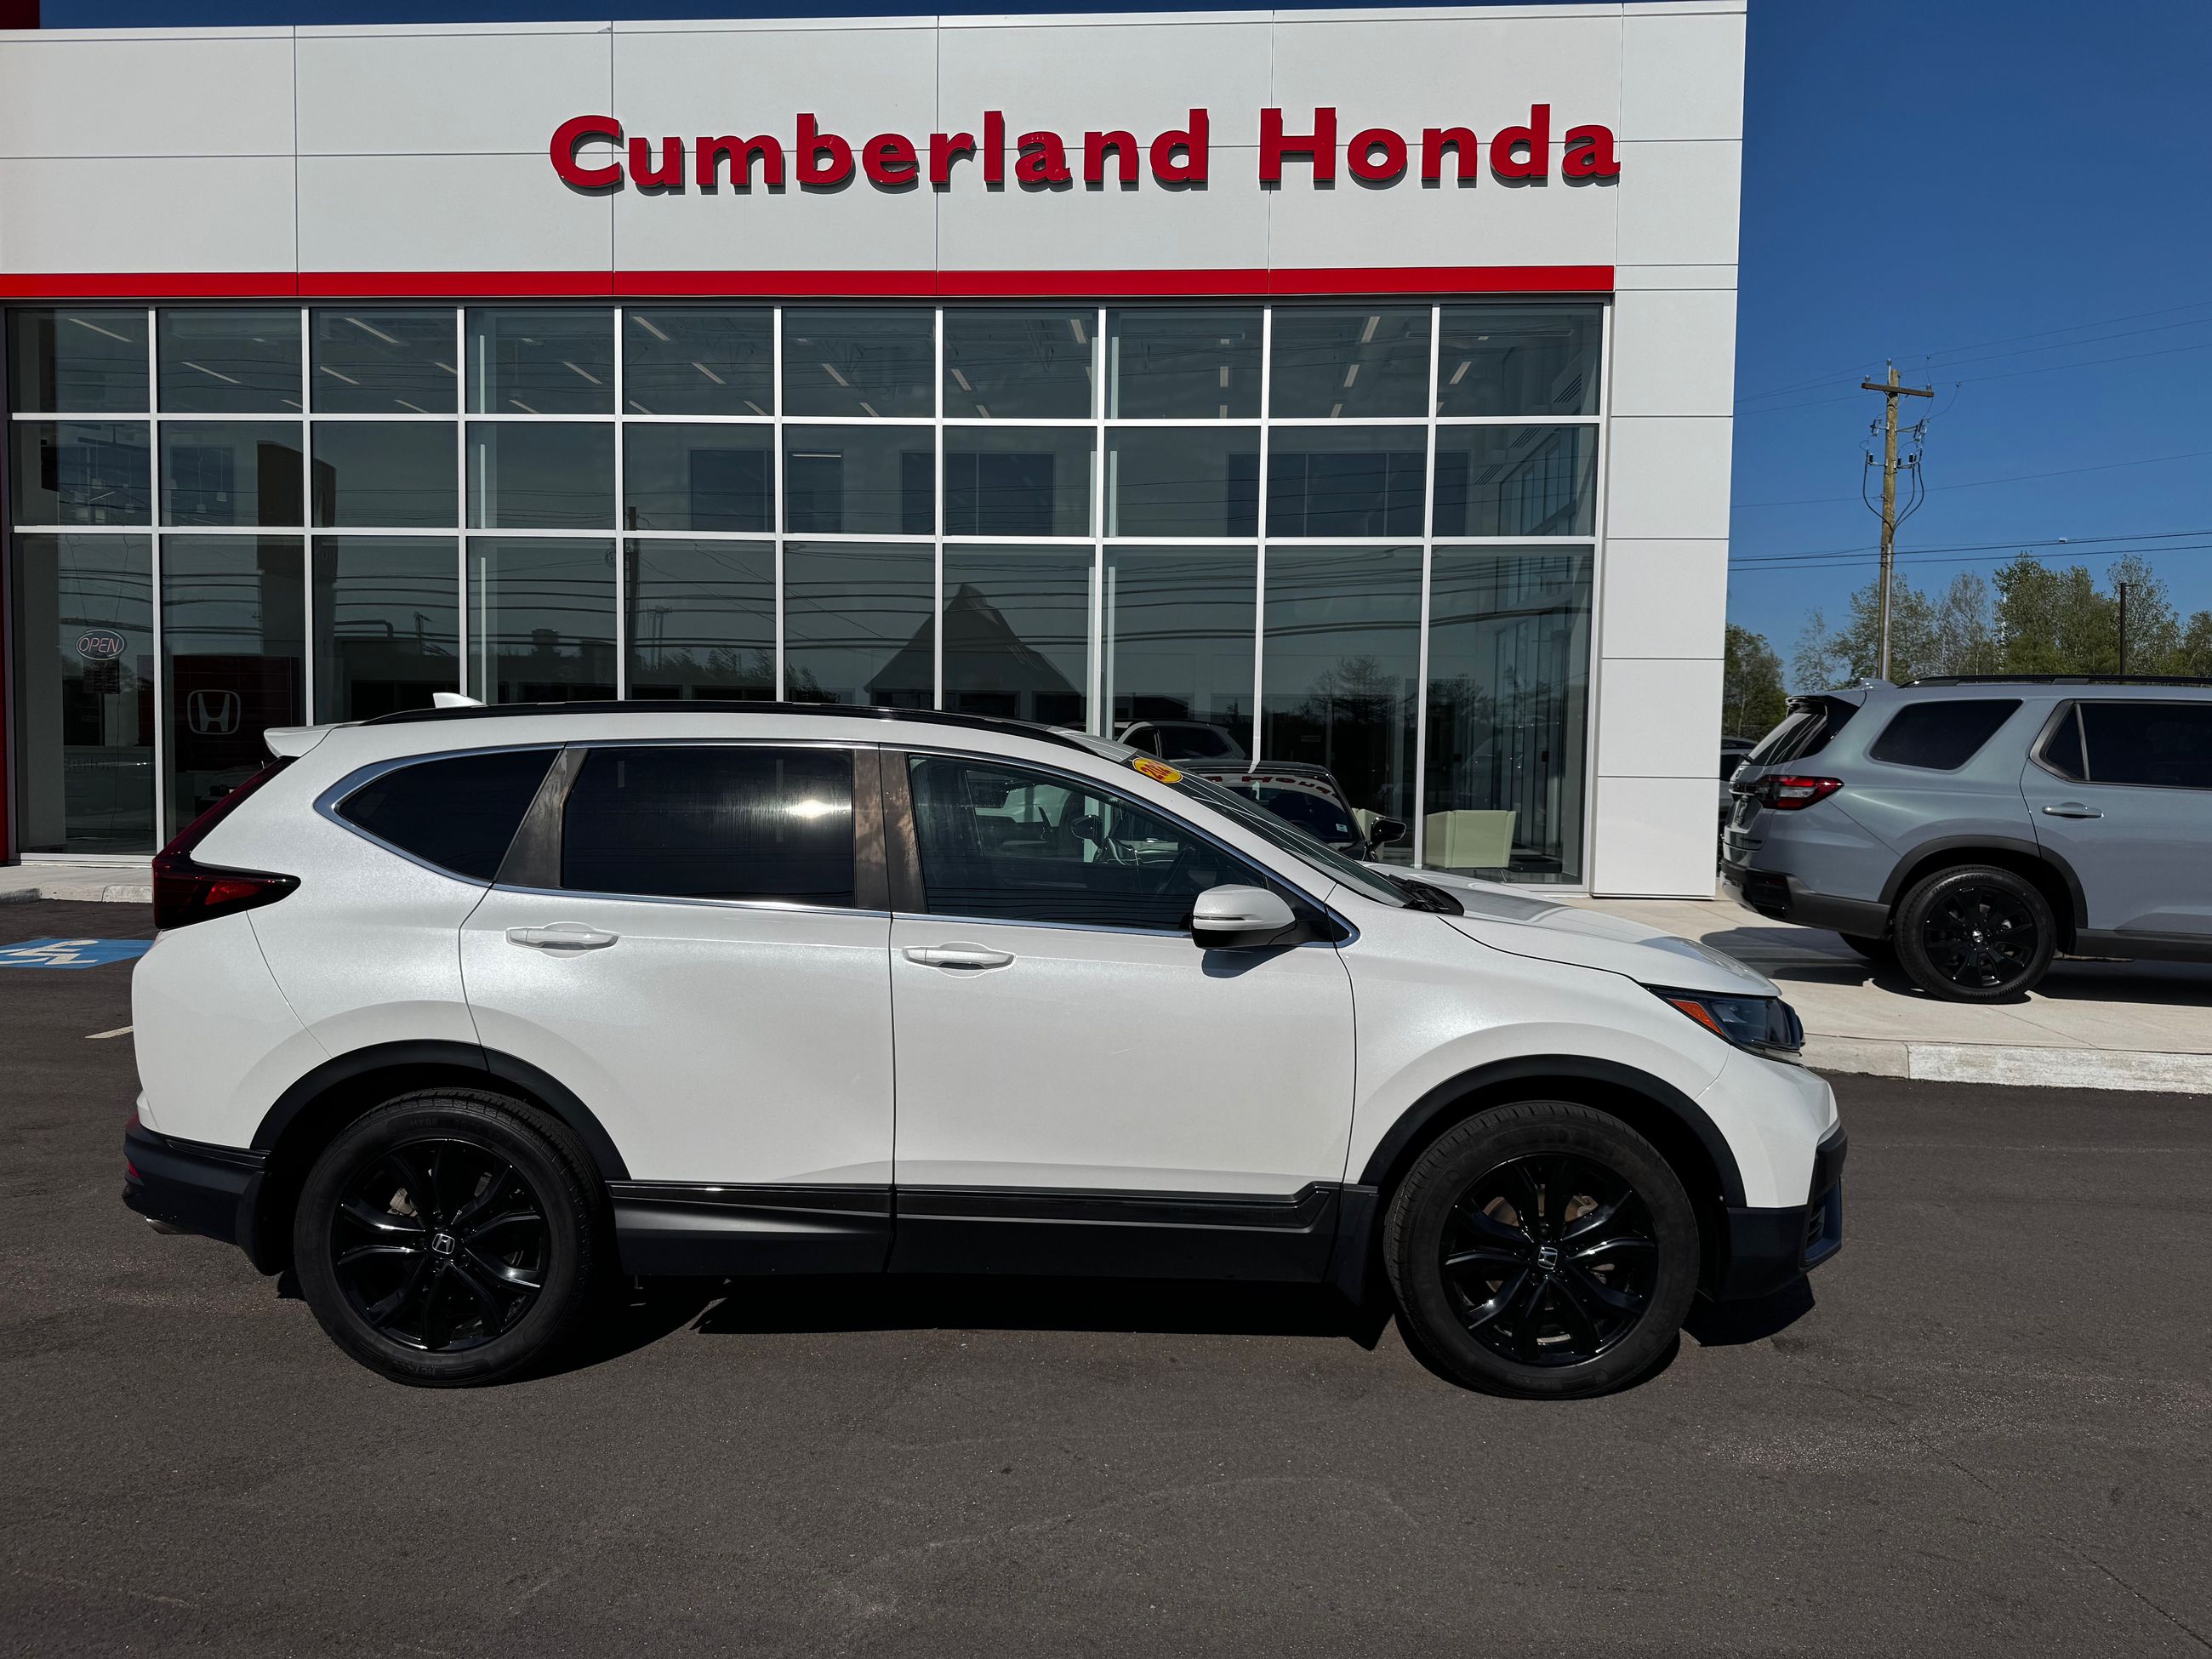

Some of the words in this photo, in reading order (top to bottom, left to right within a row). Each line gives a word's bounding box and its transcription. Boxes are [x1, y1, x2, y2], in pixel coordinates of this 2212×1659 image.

[550, 108, 1208, 186] Cumberland
[1258, 104, 1621, 181] Honda
[78, 637, 120, 653] OPEN
